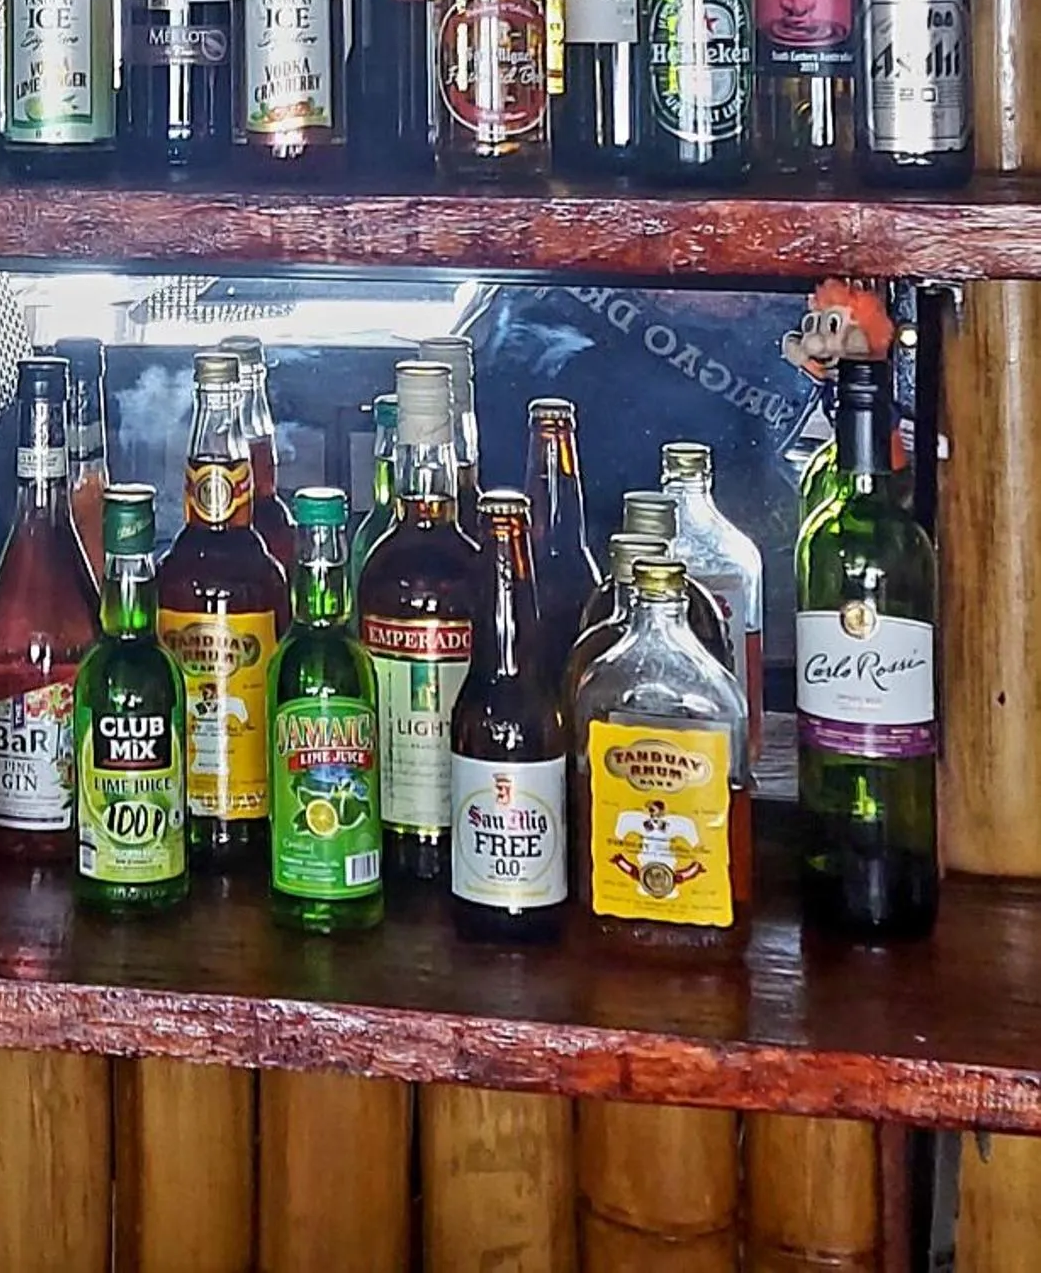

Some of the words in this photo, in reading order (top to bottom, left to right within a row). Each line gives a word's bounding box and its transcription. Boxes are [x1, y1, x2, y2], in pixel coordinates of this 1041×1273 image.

[652, 42, 751, 65] Heeken
[804, 653, 855, 685] Carlo
[857, 648, 927, 692] Rossi
[99, 716, 165, 738] CLUB
[613, 750, 703, 774] TANDUAY
[629, 764, 683, 780] RHUM
[1, 773, 38, 791] GIN
[94, 776, 128, 794] LIME
[134, 776, 173, 794] JUICE
[467, 804, 505, 831] San
[507, 809, 548, 834] Mig
[474, 830, 542, 858] FREE
